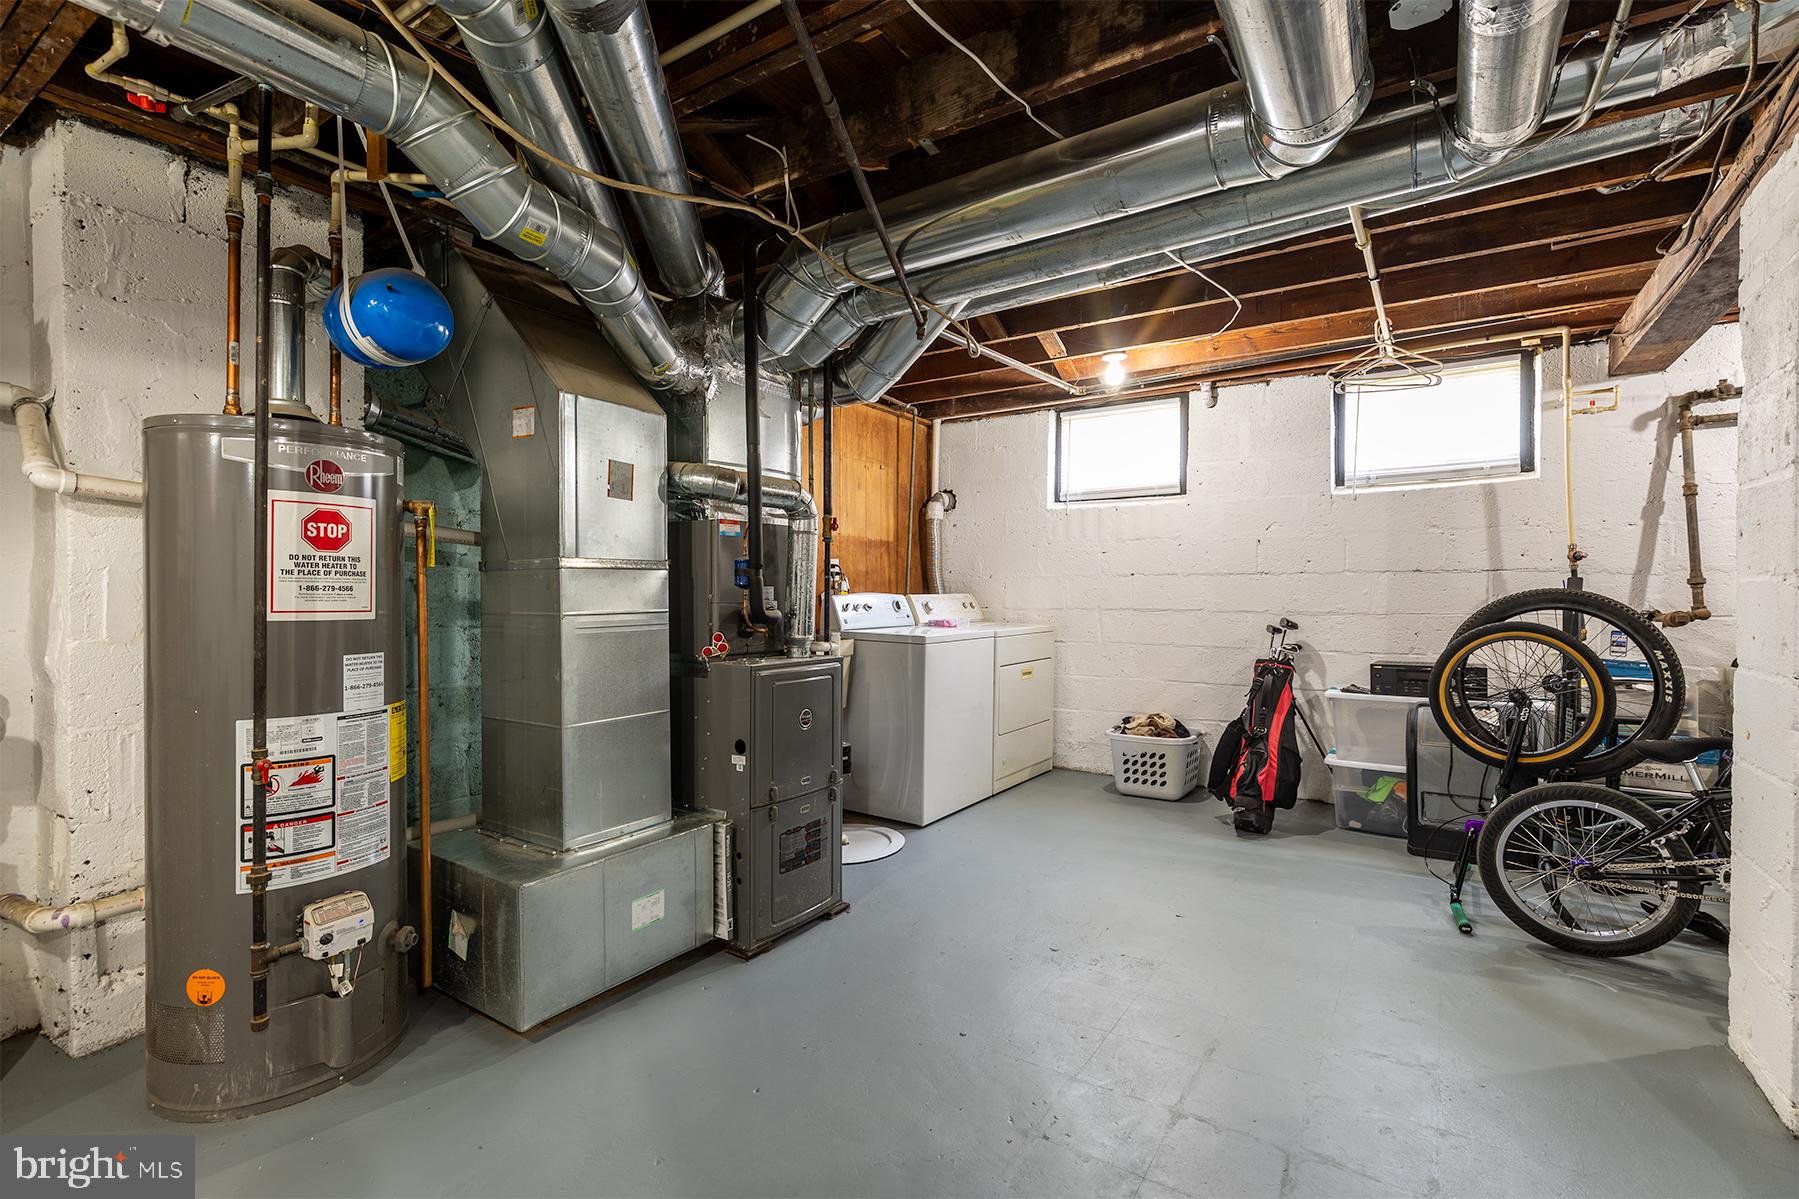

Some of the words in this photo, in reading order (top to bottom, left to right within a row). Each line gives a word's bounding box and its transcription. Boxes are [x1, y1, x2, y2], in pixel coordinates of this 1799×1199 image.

[278, 444, 367, 463] PERFOMANCE
[309, 459, 343, 488] Rheem
[306, 522, 348, 539] STOP
[321, 562, 348, 570] HEATER
[1653, 649, 1673, 703] MAXXIS
[1624, 770, 1688, 782] MERMILL
[280, 820, 307, 828] DANGER
